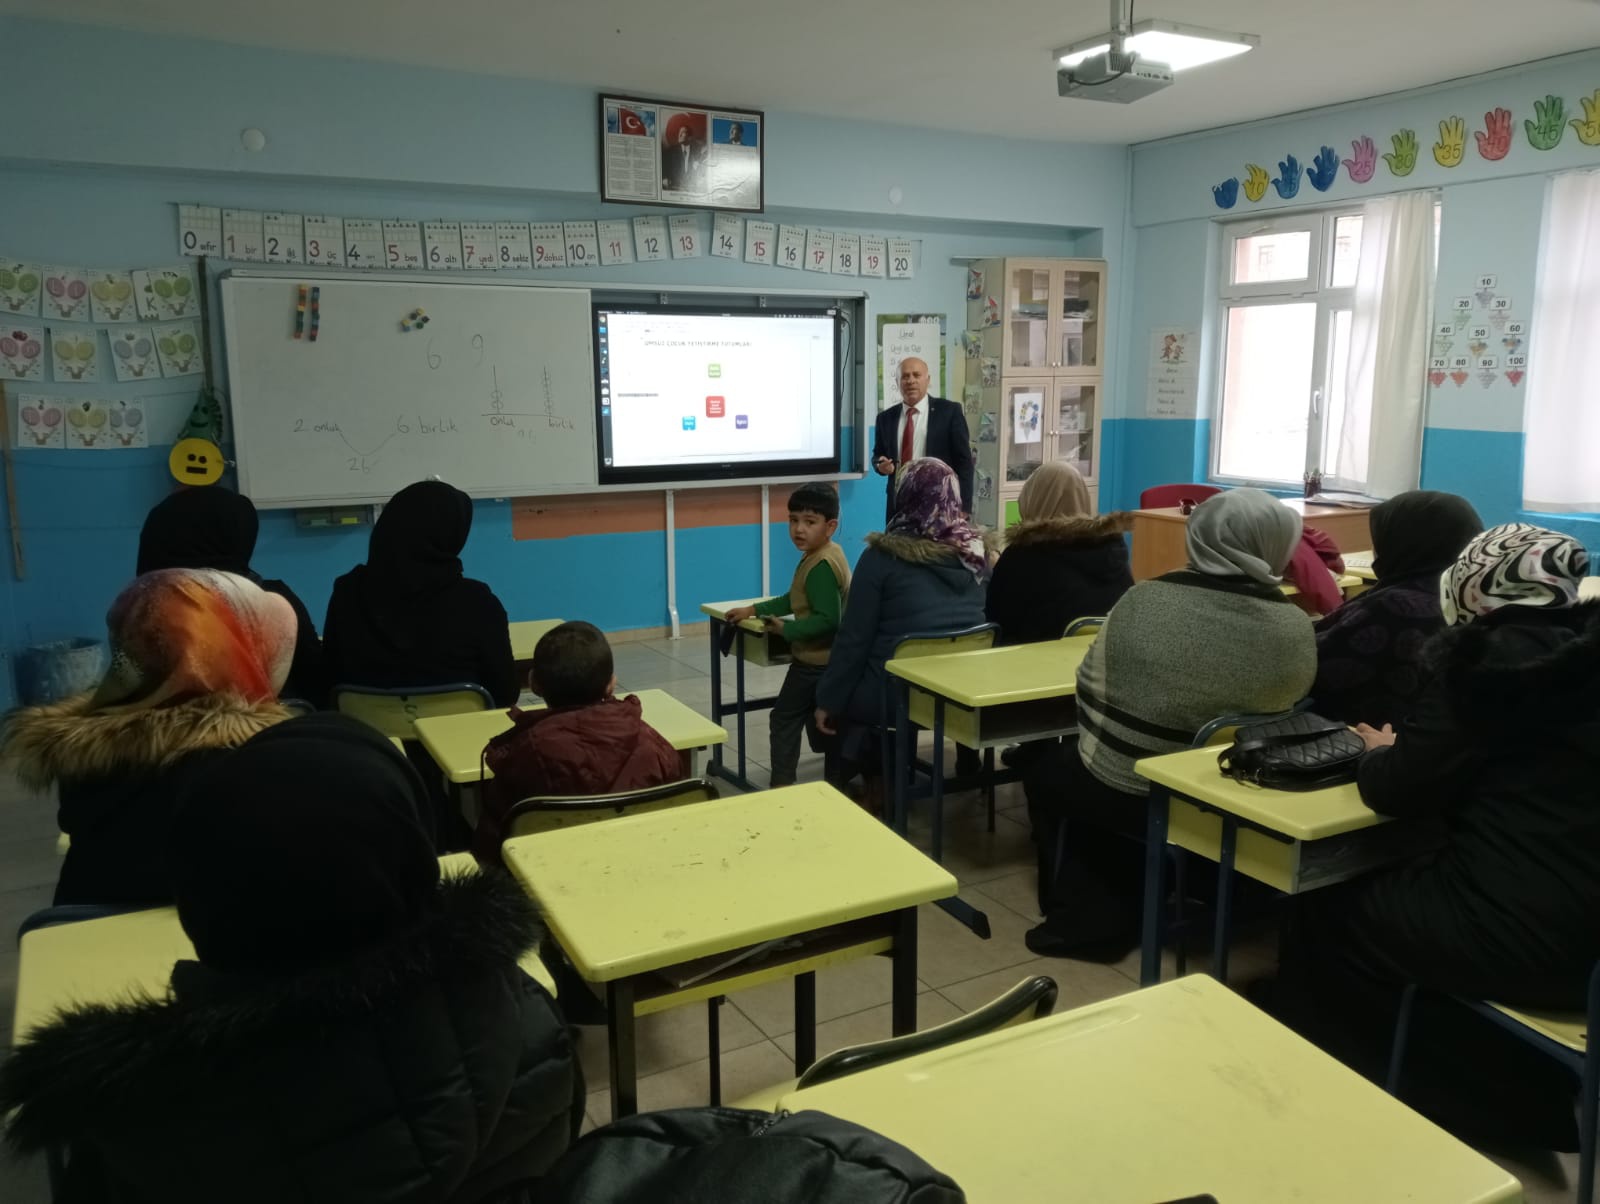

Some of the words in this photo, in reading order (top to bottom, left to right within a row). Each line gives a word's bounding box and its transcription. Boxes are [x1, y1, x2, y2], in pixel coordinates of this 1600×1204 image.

[1537, 124, 1559, 141] 45
[1586, 121, 1600, 138] 5
[1441, 144, 1463, 161] 35
[1486, 136, 1510, 153] 40
[1354, 161, 1372, 177] 25
[184, 231, 197, 249] 0
[227, 235, 235, 253] 1
[268, 237, 279, 256] 2
[645, 238, 659, 254] 12
[680, 236, 694, 251] 13
[720, 235, 734, 250] 14
[309, 240, 320, 257] 3
[348, 244, 361, 261] 4
[388, 244, 400, 262] 5
[430, 246, 440, 263] 6
[465, 246, 475, 262] 7
[500, 246, 510, 262] 8
[535, 246, 545, 262] 9
[569, 244, 586, 260] 10
[610, 242, 622, 257] 11
[754, 241, 766, 256] 15
[785, 247, 797, 261] 16
[814, 251, 825, 265] 17
[840, 254, 852, 268] 18
[867, 256, 879, 270] 19
[895, 258, 908, 271] 20
[1481, 278, 1491, 286] 10
[146, 297, 157, 311] K
[1459, 300, 1470, 308] 20
[1495, 300, 1506, 308] 30
[1440, 326, 1451, 334] 40
[1475, 329, 1486, 337] 50
[1510, 324, 1521, 332] 60
[427, 336, 442, 370] 6
[471, 334, 484, 369] 9
[1434, 359, 1445, 367] 70
[1456, 358, 1466, 366] 80
[1482, 359, 1493, 367] 90
[1509, 357, 1524, 365] 100
[293, 418, 308, 433] 2
[397, 414, 410, 434] 6
[347, 456, 370, 474] 26
